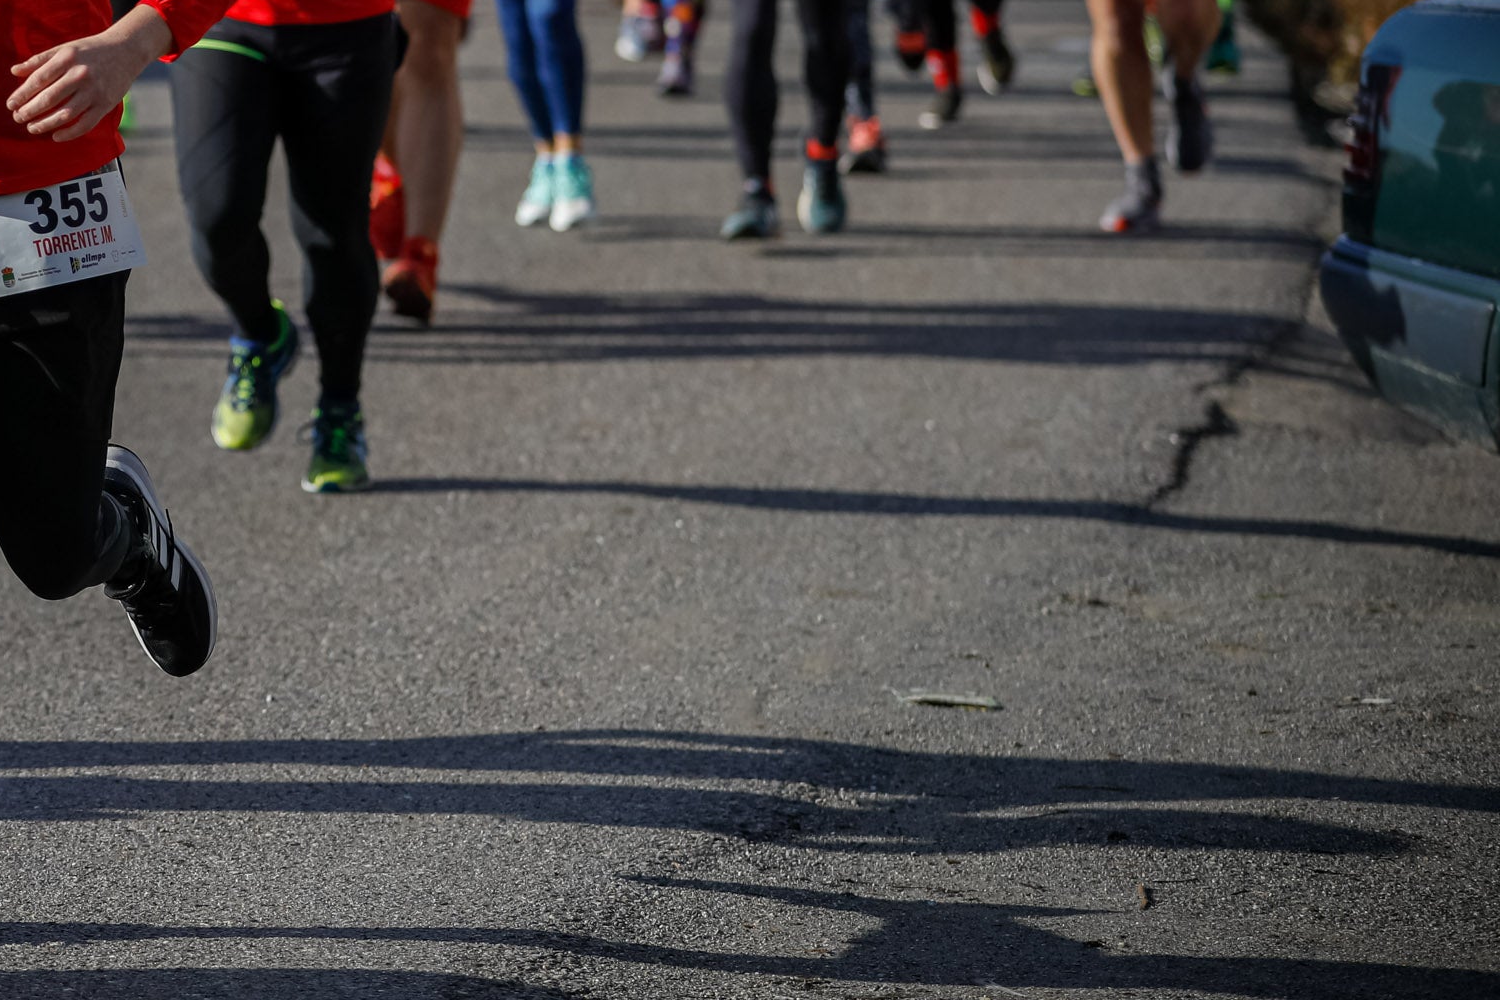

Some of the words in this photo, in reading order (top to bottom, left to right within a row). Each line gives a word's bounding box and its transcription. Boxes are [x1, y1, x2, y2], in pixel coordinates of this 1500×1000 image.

[24, 178, 108, 234] 355
[33, 228, 99, 257] TORRENTE
[81, 252, 106, 264] olimpo
